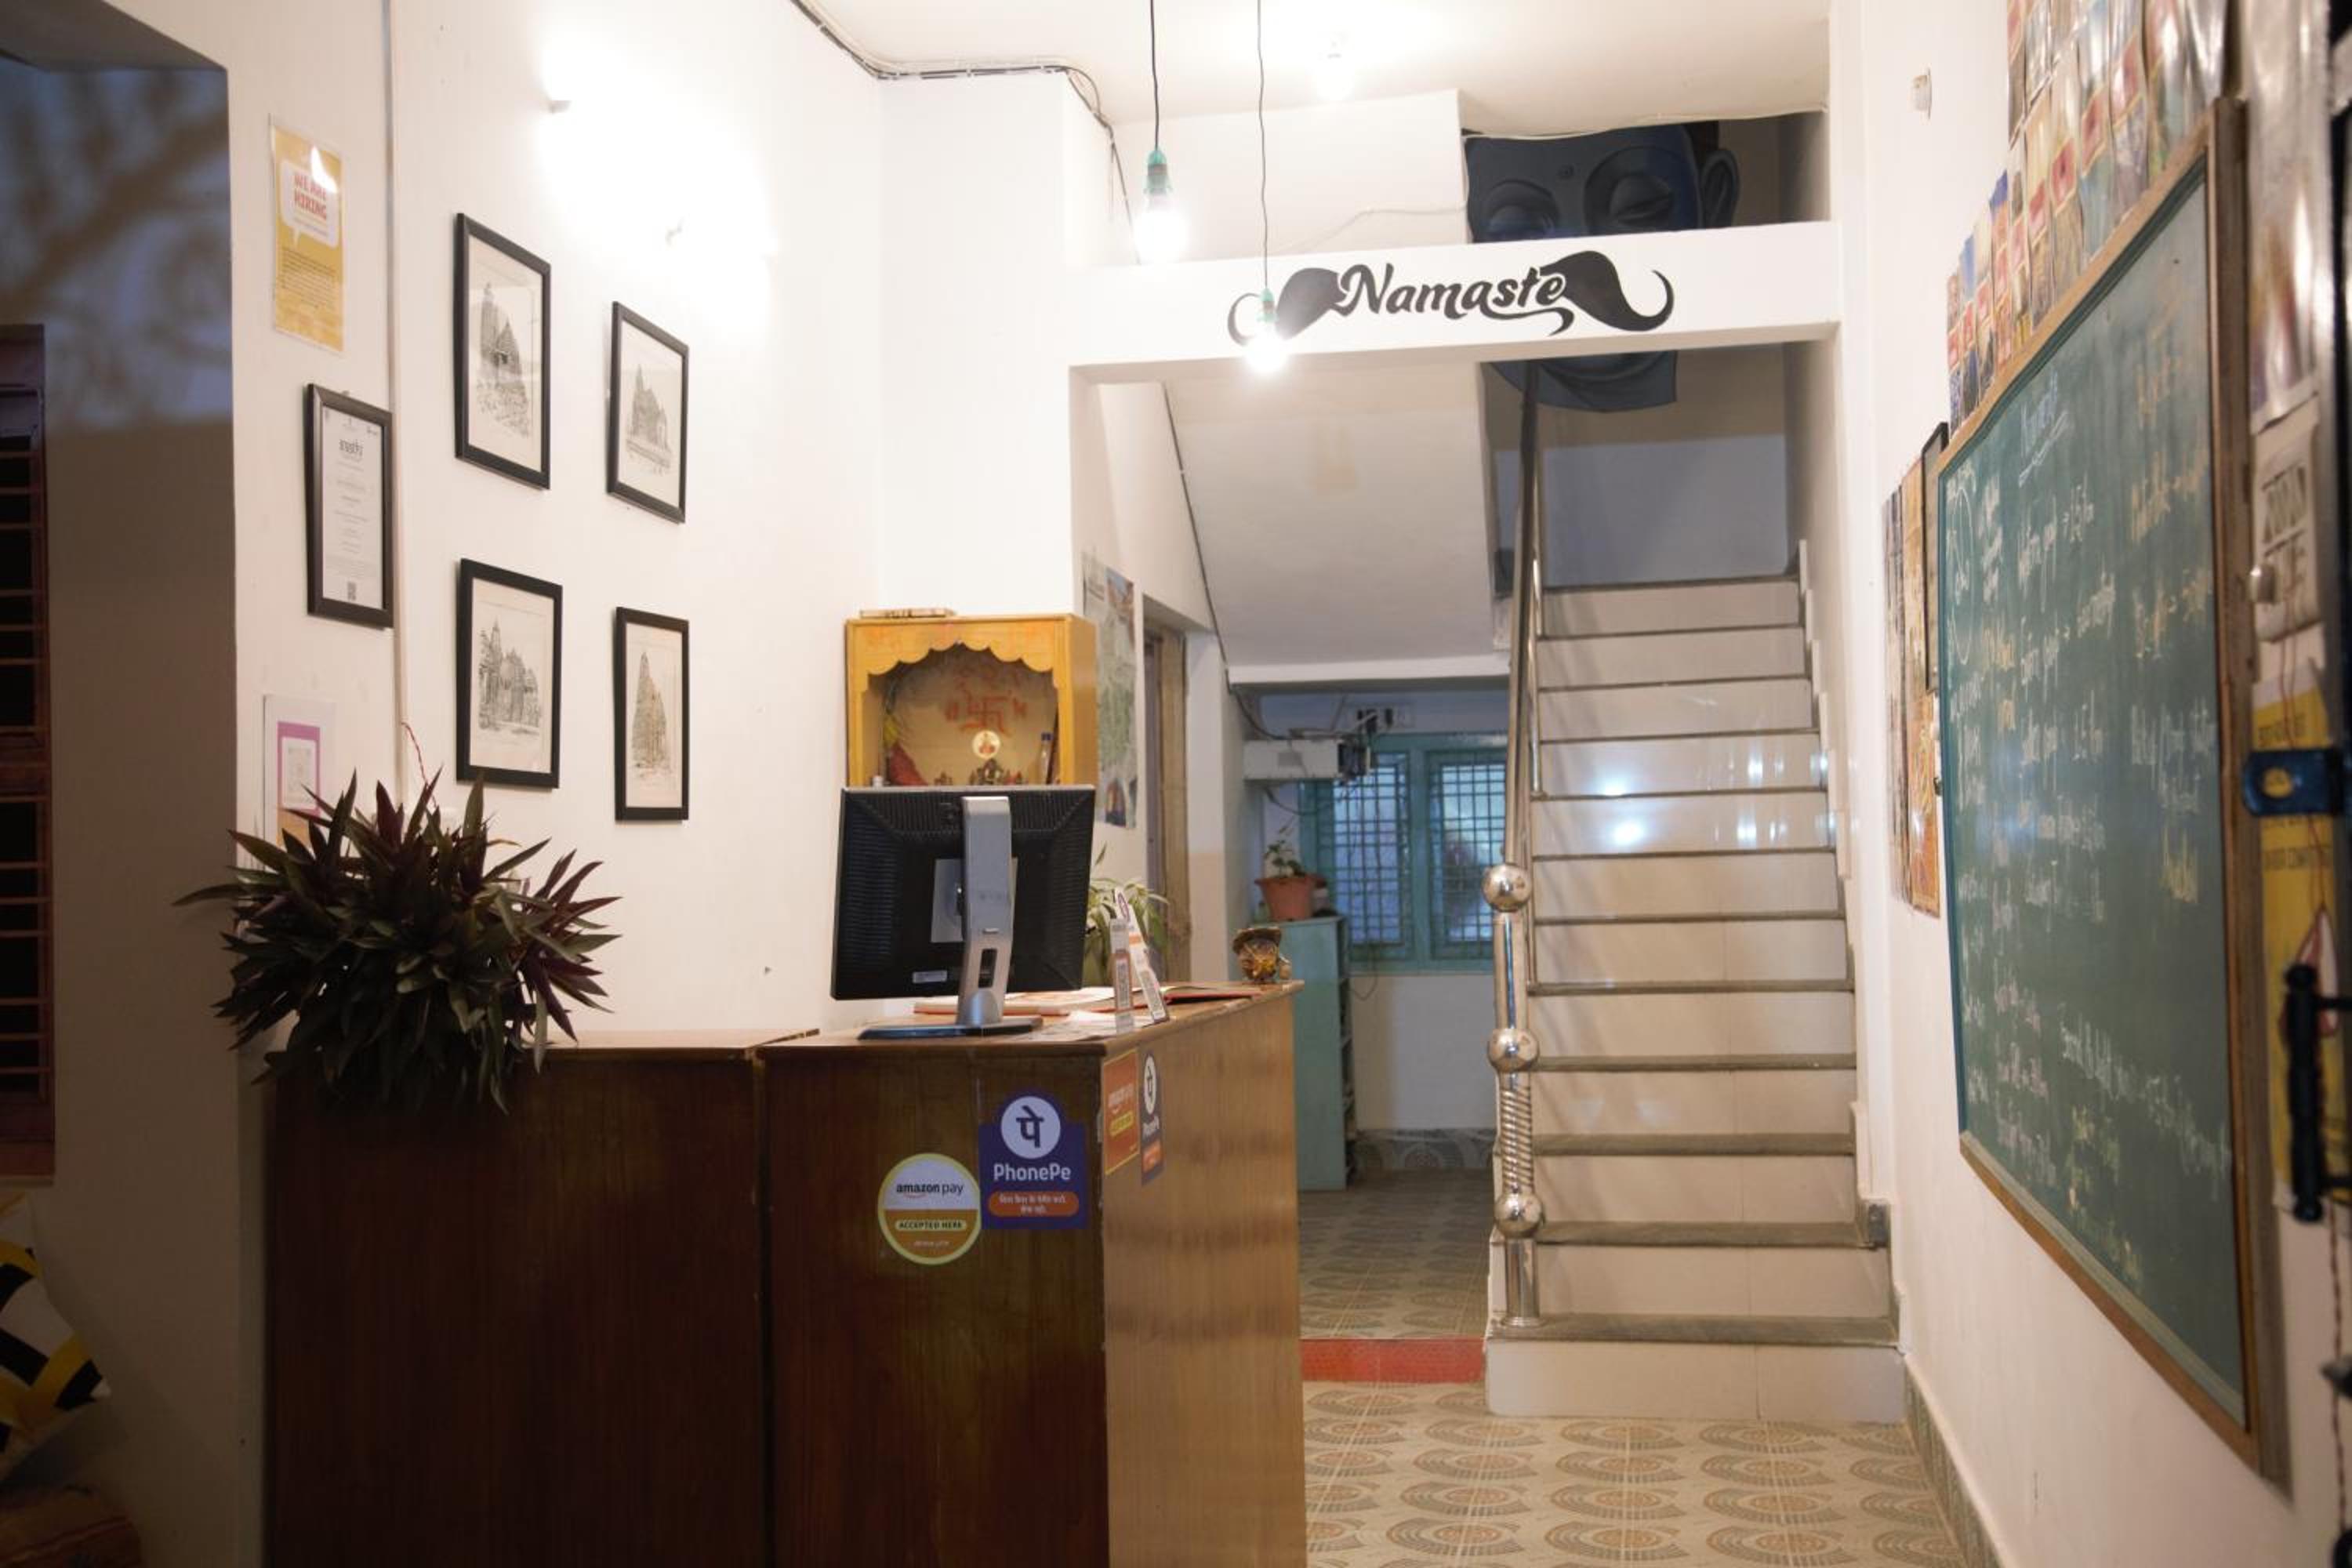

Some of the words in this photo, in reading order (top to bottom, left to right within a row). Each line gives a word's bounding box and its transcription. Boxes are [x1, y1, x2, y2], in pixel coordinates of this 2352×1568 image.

[294, 188, 327, 221] HIRING
[1333, 263, 1575, 337] Namaste
[1015, 1105, 1045, 1149] पे
[993, 1162, 1072, 1181] PhonePe
[896, 1183, 940, 1193] amazon
[942, 1183, 964, 1197] pay
[898, 1221, 940, 1229] ACCEPTED
[942, 1221, 962, 1229] HERE
